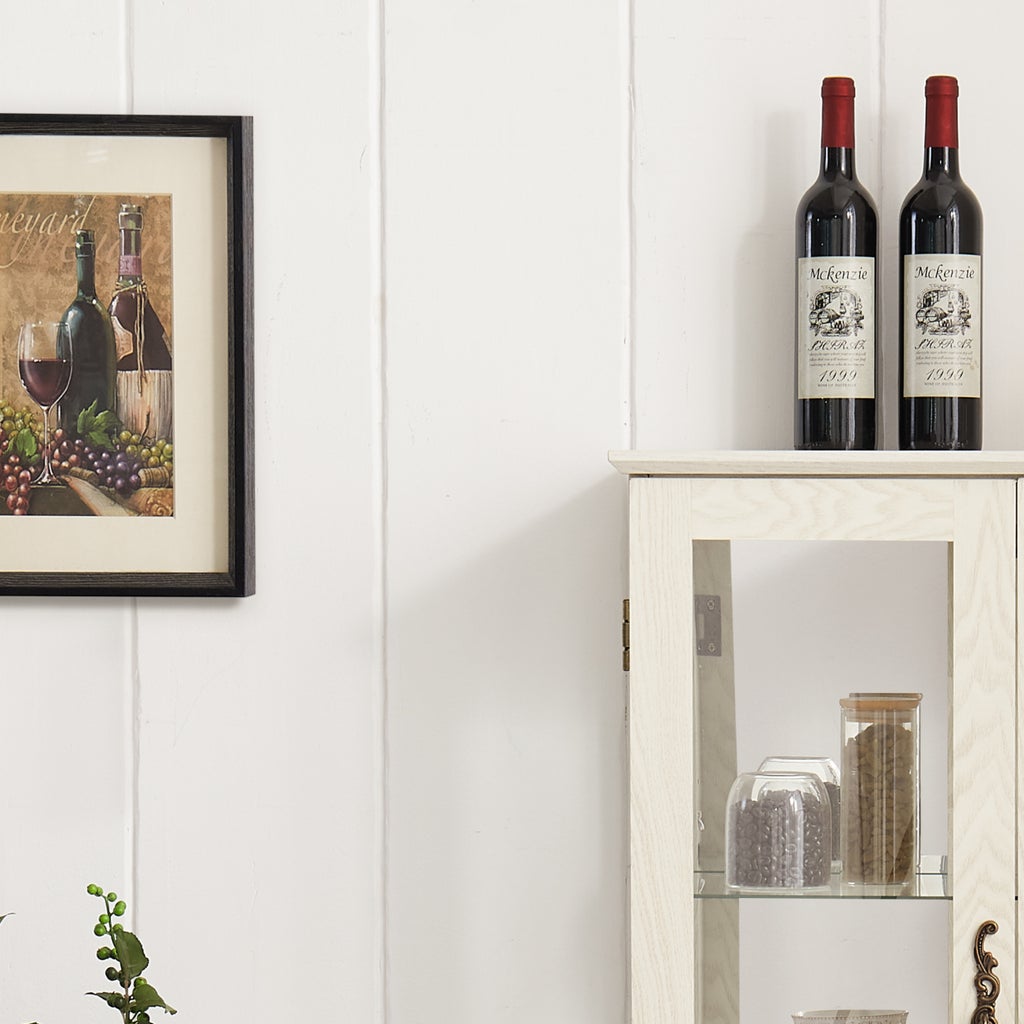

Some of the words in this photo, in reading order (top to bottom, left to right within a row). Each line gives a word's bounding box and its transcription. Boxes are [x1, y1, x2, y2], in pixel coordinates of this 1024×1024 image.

[808, 265, 868, 283] Mckenzie
[914, 264, 975, 282] Mckenzie
[819, 369, 857, 382] 1999
[925, 368, 964, 381] 1999
